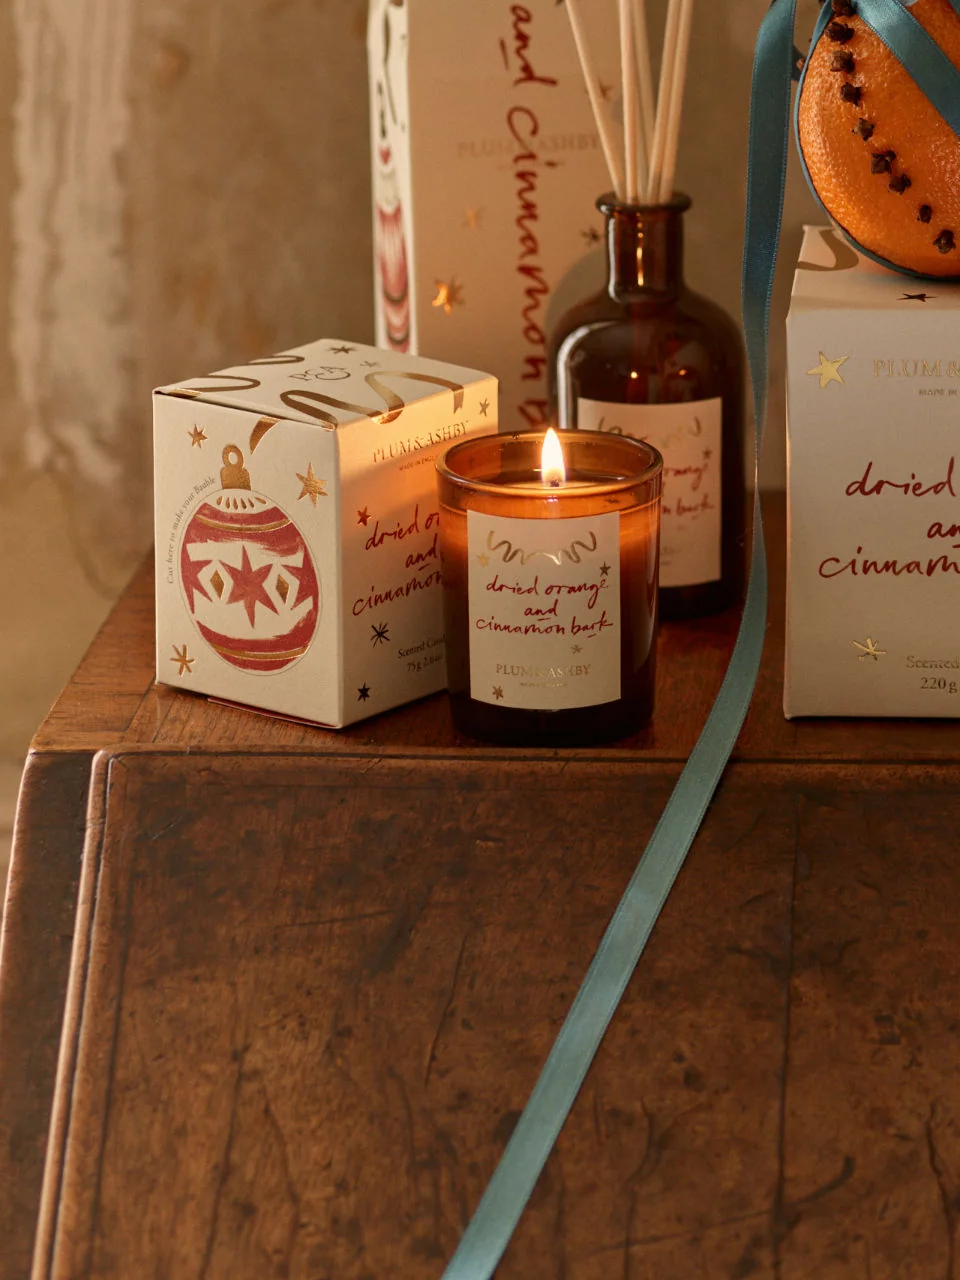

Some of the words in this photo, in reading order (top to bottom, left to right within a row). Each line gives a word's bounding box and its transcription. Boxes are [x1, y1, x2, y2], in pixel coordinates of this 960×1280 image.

[499, 3, 557, 87] and
[506, 105, 557, 381] cinnamon
[845, 456, 956, 498] dried
[365, 504, 420, 550] dried
[405, 533, 438, 571] and
[486, 575, 540, 596] dried
[544, 577, 609, 609] orange
[524, 599, 558, 621] and
[475, 616, 565, 636] cinnamon
[570, 610, 614, 638] bark
[905, 654, 960, 670] Scented
